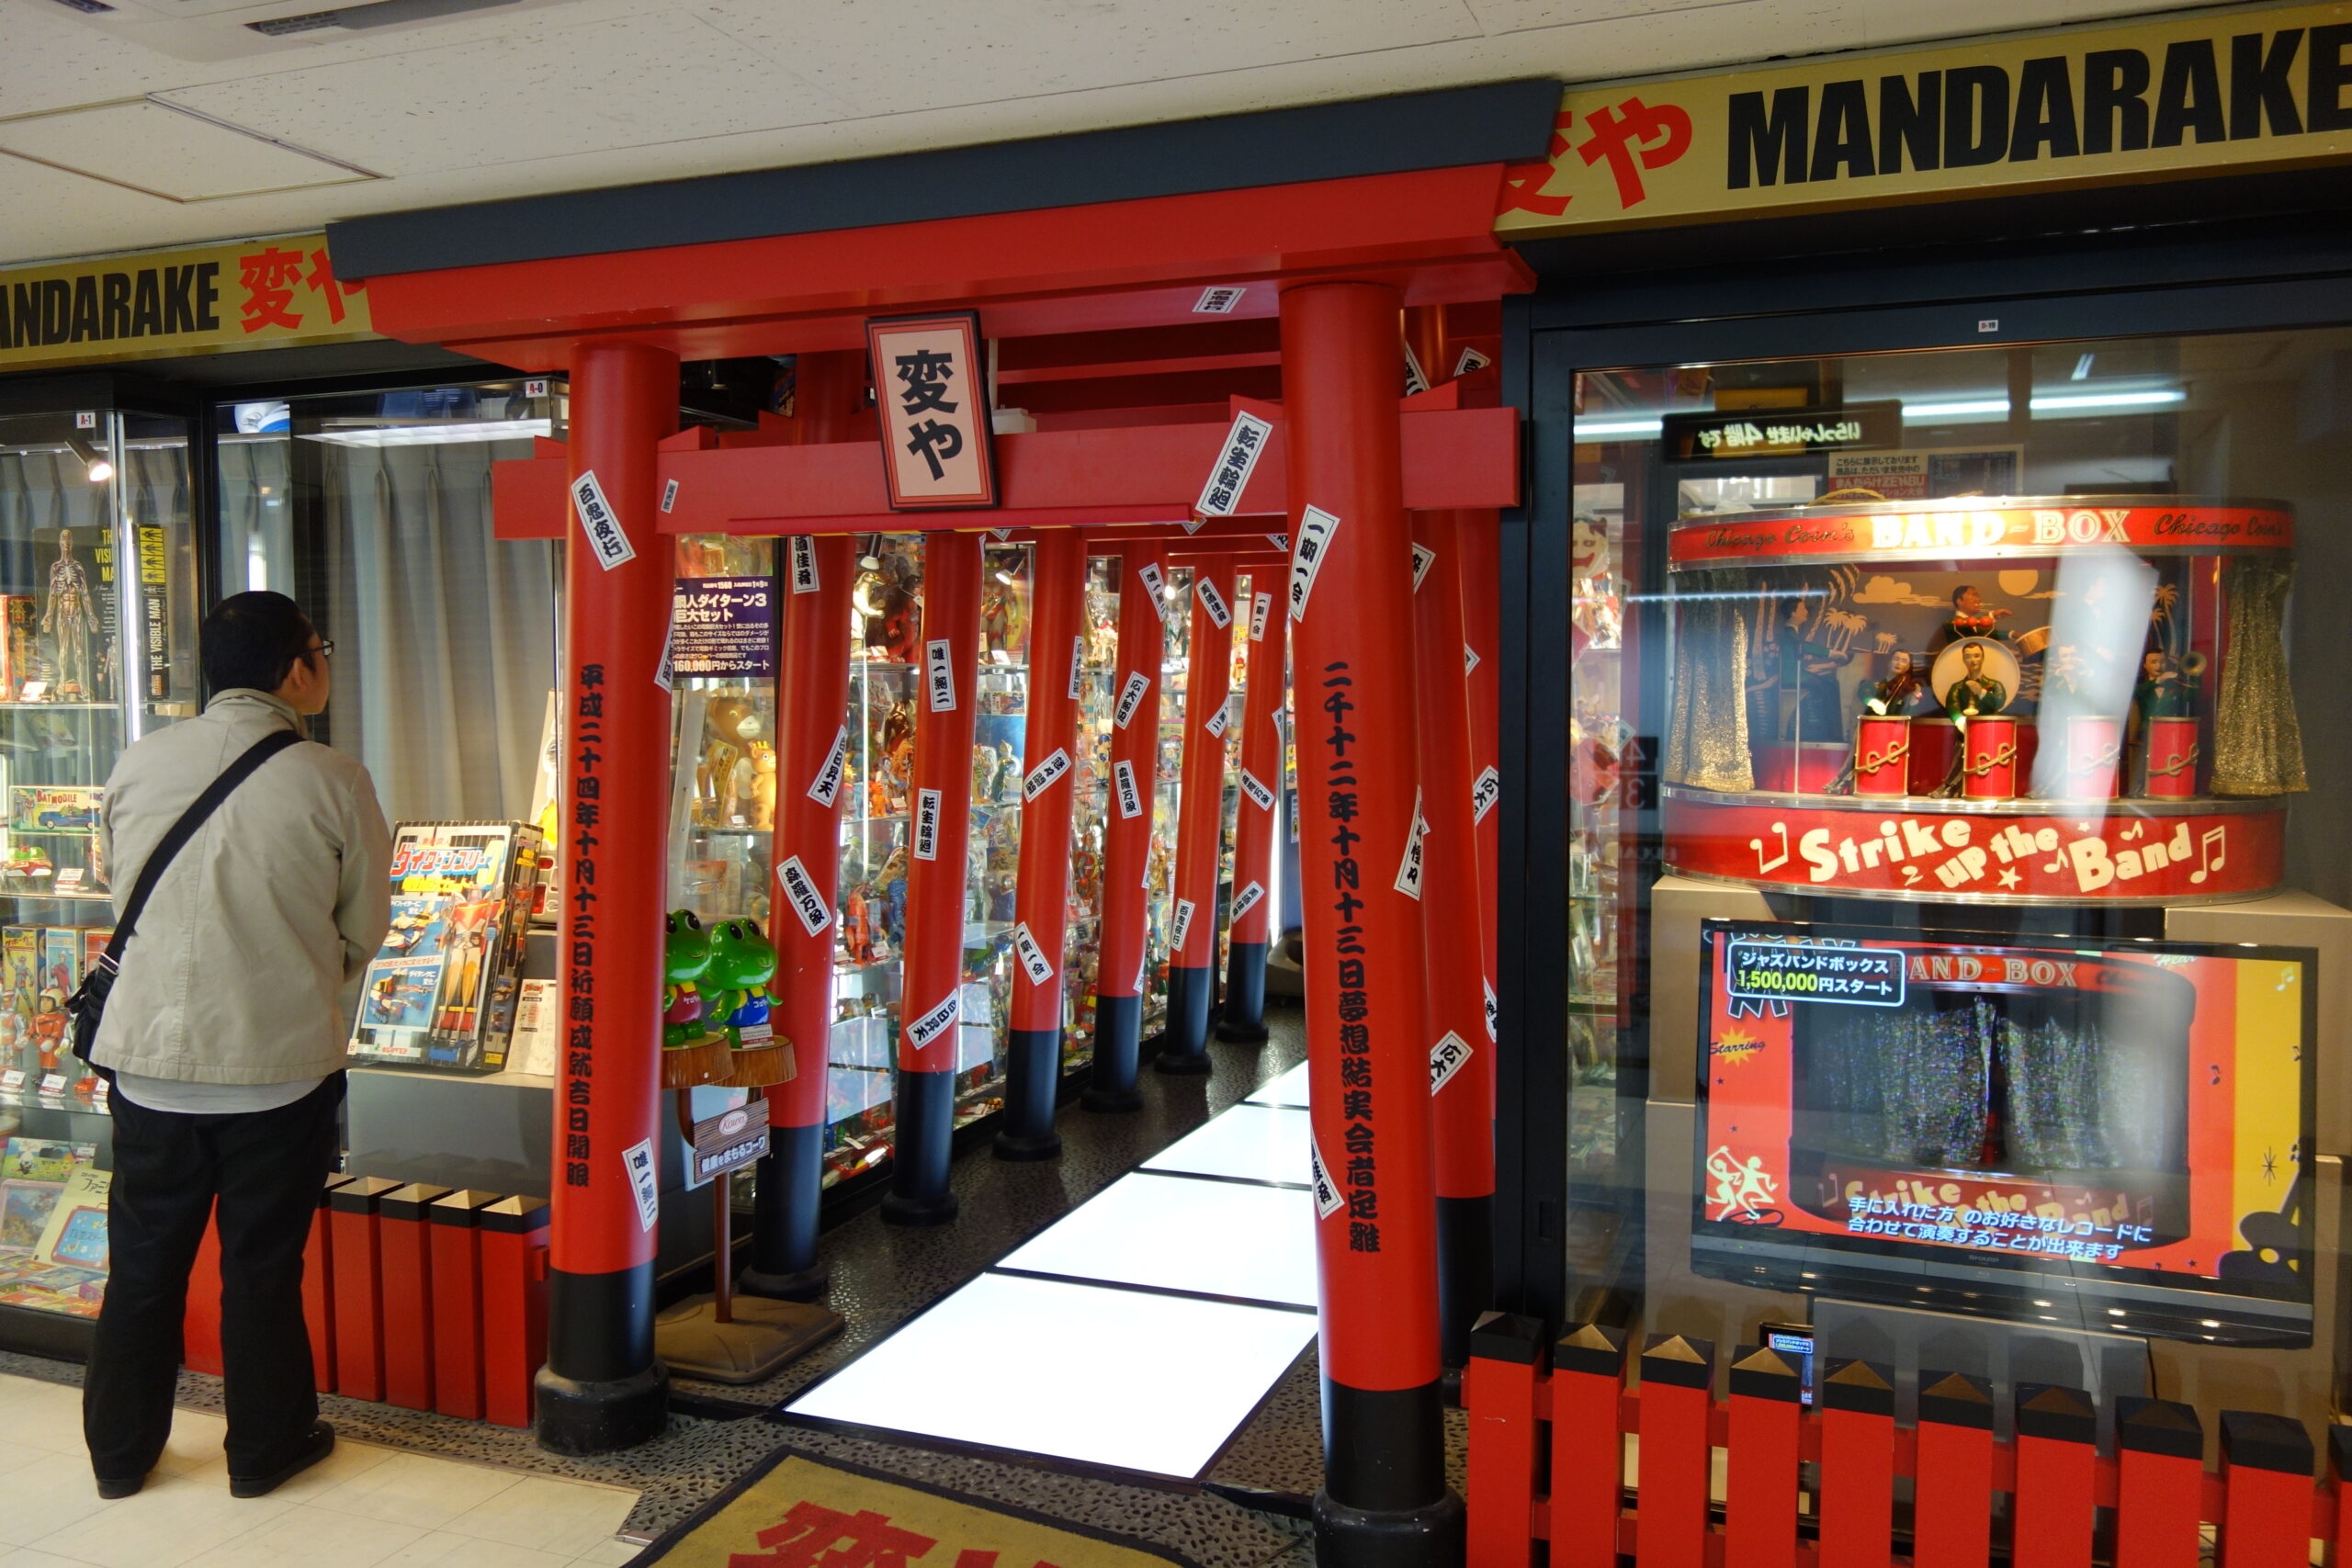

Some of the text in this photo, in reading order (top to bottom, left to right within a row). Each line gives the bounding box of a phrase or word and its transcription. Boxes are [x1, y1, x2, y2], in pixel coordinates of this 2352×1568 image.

[1726, 22, 2352, 191] MANDARAKE
[529, 382, 543, 394] A-0
[80, 414, 92, 425] A-1
[895, 349, 964, 481] 変や
[1207, 424, 1261, 512] 転生輪廻
[102, 529, 113, 545] TH
[578, 483, 623, 558] 百鬼夜行
[1705, 523, 1855, 550] Chicago Coin's
[2154, 513, 2240, 541] Chicago
[95, 547, 113, 564] VISI
[1291, 523, 1326, 606] 一期一会
[102, 566, 115, 581] MA
[148, 598, 161, 619] MAN
[673, 592, 767, 608] 鋼人ダイターン3
[673, 608, 734, 624] 巨大セット
[1252, 598, 1267, 635] 一期一会
[150, 620, 163, 653] VISIBLE
[151, 655, 163, 671] THE
[931, 647, 951, 704] 唯一無二
[36, 789, 77, 805] BATMOBILE
[1118, 766, 1137, 813] 森羅万象
[919, 795, 935, 854] 転生輪廻
[1800, 819, 2194, 893] Strike up the Band
[785, 866, 826, 927] 森羅万象
[1018, 931, 1045, 976] 一期一会
[1742, 952, 1890, 975] ジャズバンドボックス
[1737, 969, 1893, 996] 1,500,000円スタート
[913, 998, 957, 1042] 白日昇天
[1710, 1040, 1766, 1055] Starring
[632, 1149, 656, 1219] 唯一無二
[1848, 1196, 2154, 1244] 手に入れた方 のお好きなレコードに
[1847, 1216, 2125, 1261] 合わせて演奏することが出来ます
